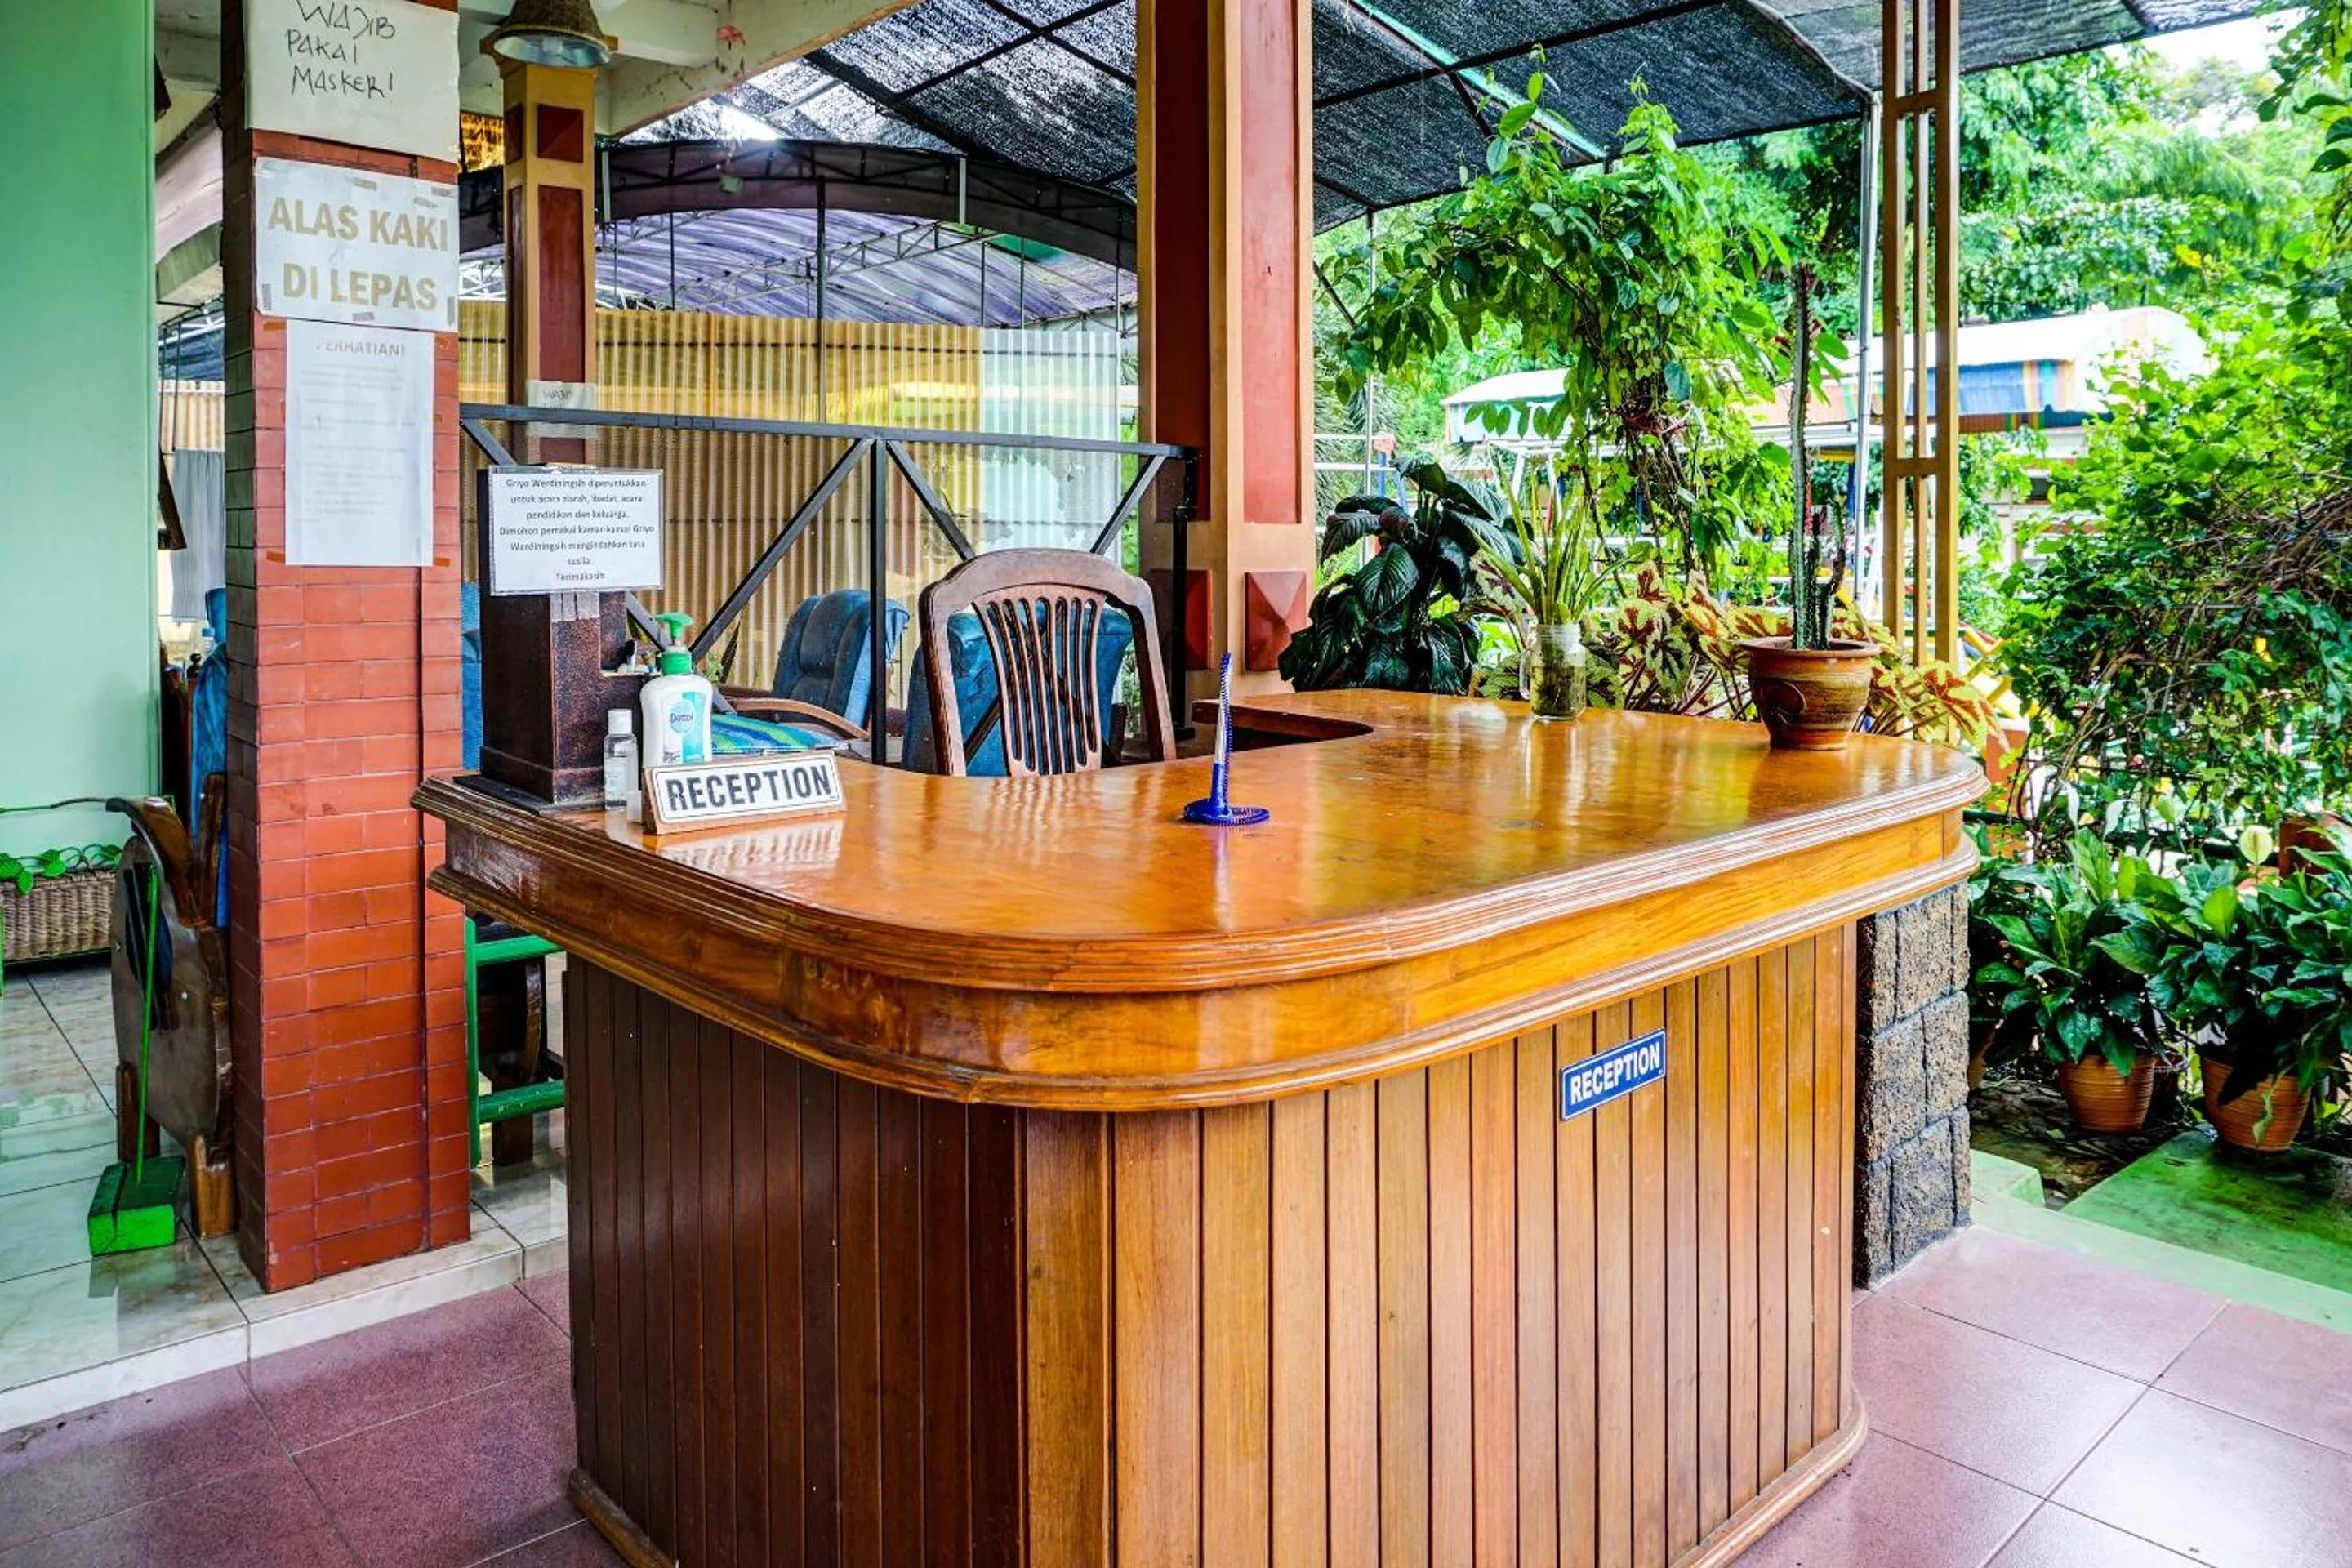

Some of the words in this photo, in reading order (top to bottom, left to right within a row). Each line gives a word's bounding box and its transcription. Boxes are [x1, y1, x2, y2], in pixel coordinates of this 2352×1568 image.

[296, 0, 396, 39] WAJIB
[287, 29, 358, 64] PAKAI
[268, 196, 359, 241] ALAS
[369, 209, 448, 252] KAKI
[283, 262, 318, 300] DI
[330, 267, 438, 310] LEPAS
[510, 495, 536, 503] untuk
[526, 510, 573, 520] pendidikan
[575, 510, 590, 519] dan
[499, 527, 539, 536] Dimohon
[577, 526, 631, 535] kamar-kamar
[665, 765, 832, 811] RECEPTION
[1570, 1041, 1660, 1105] RECEPTION
